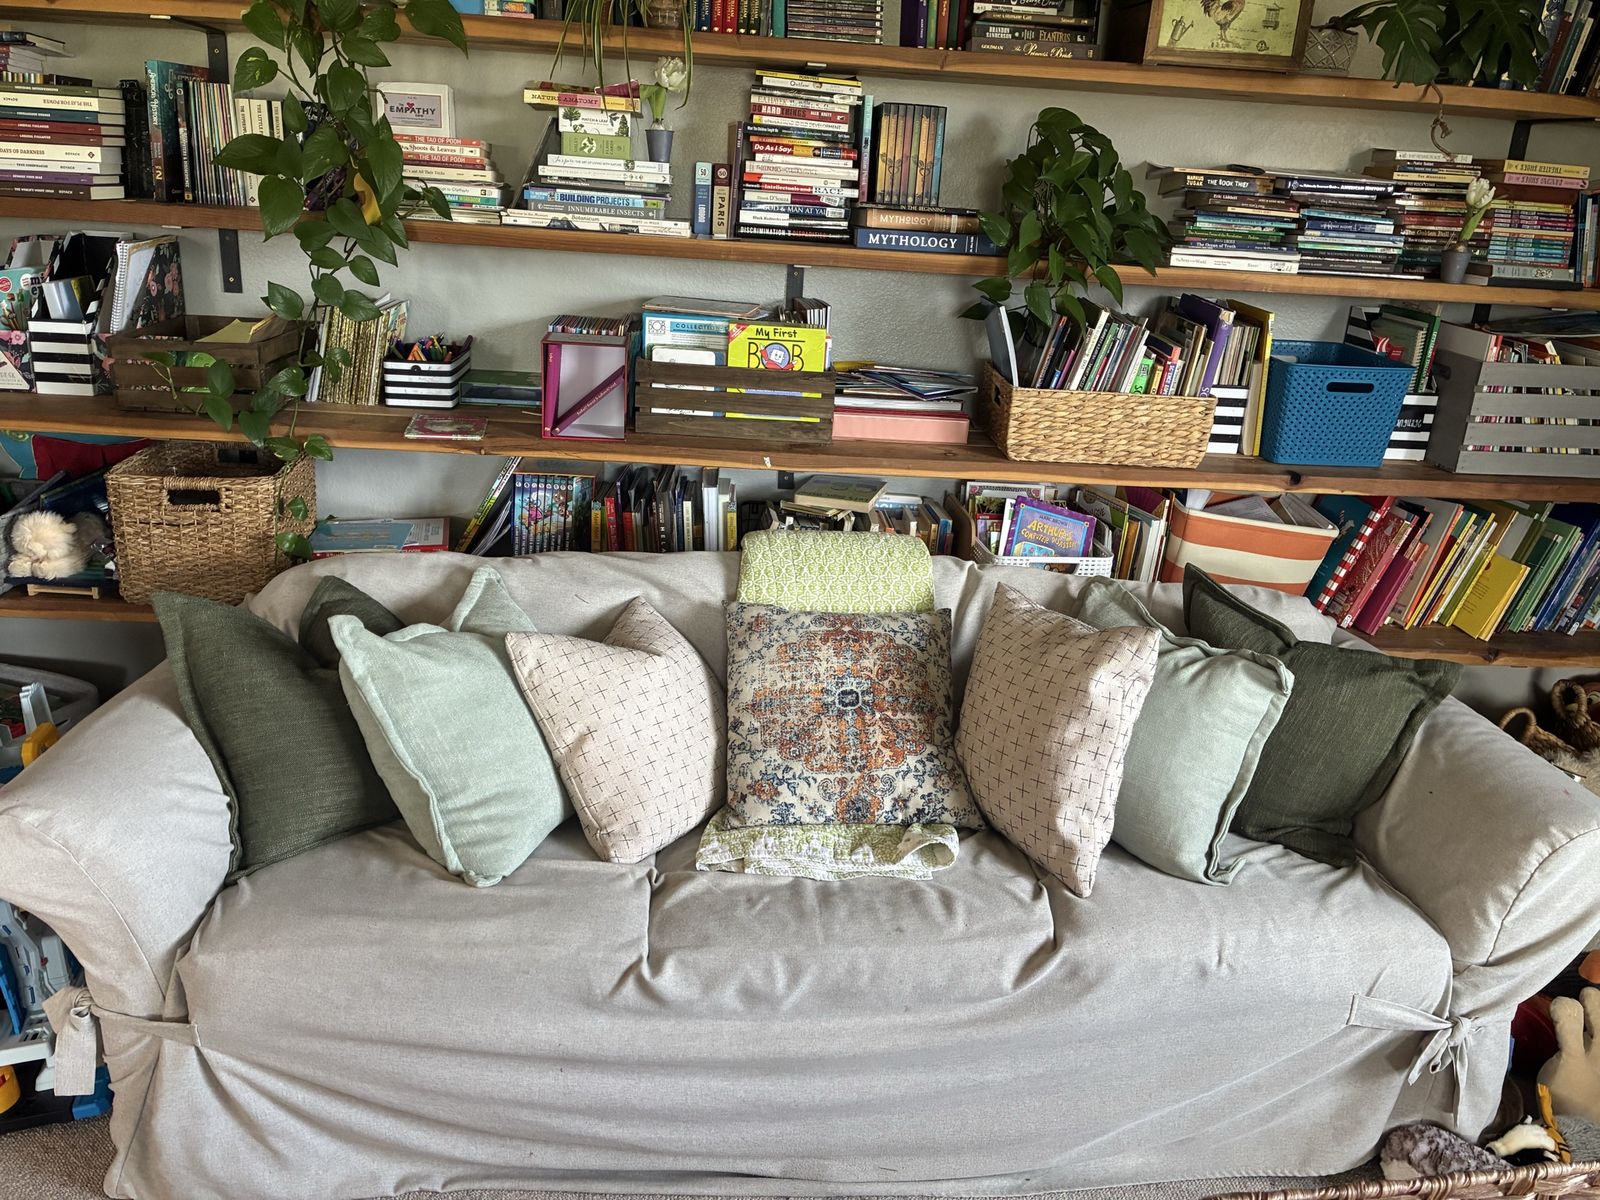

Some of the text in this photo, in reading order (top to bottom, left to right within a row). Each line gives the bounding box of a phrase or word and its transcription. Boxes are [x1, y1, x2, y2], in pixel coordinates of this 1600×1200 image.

[1039, 30, 1071, 43] ELANTRIS
[1050, 48, 1073, 58] Bride
[531, 93, 599, 105] NATURE ANATOMY
[389, 105, 436, 115] EMPATHY
[761, 105, 781, 115] HARD
[778, 145, 793, 154] Say
[418, 153, 429, 161] THE
[429, 154, 440, 162] TAO
[700, 168, 707, 176] 50
[1207, 177, 1250, 188] THE BOOK THIEF
[814, 186, 844, 195] RACE
[559, 192, 596, 204] BUILDING
[595, 195, 630, 207] PROJECTS
[567, 204, 645, 217] INNUMERABLE INSECTS
[717, 195, 727, 228] PARIS
[571, 214, 600, 222] Botanicum
[879, 213, 932, 225] MYTHOLOGY
[740, 226, 786, 236] DISCRIMINATION
[867, 232, 958, 249] MYTHOLOGY
[755, 327, 798, 339] My First
[1026, 519, 1073, 541] ARTHUR'S
